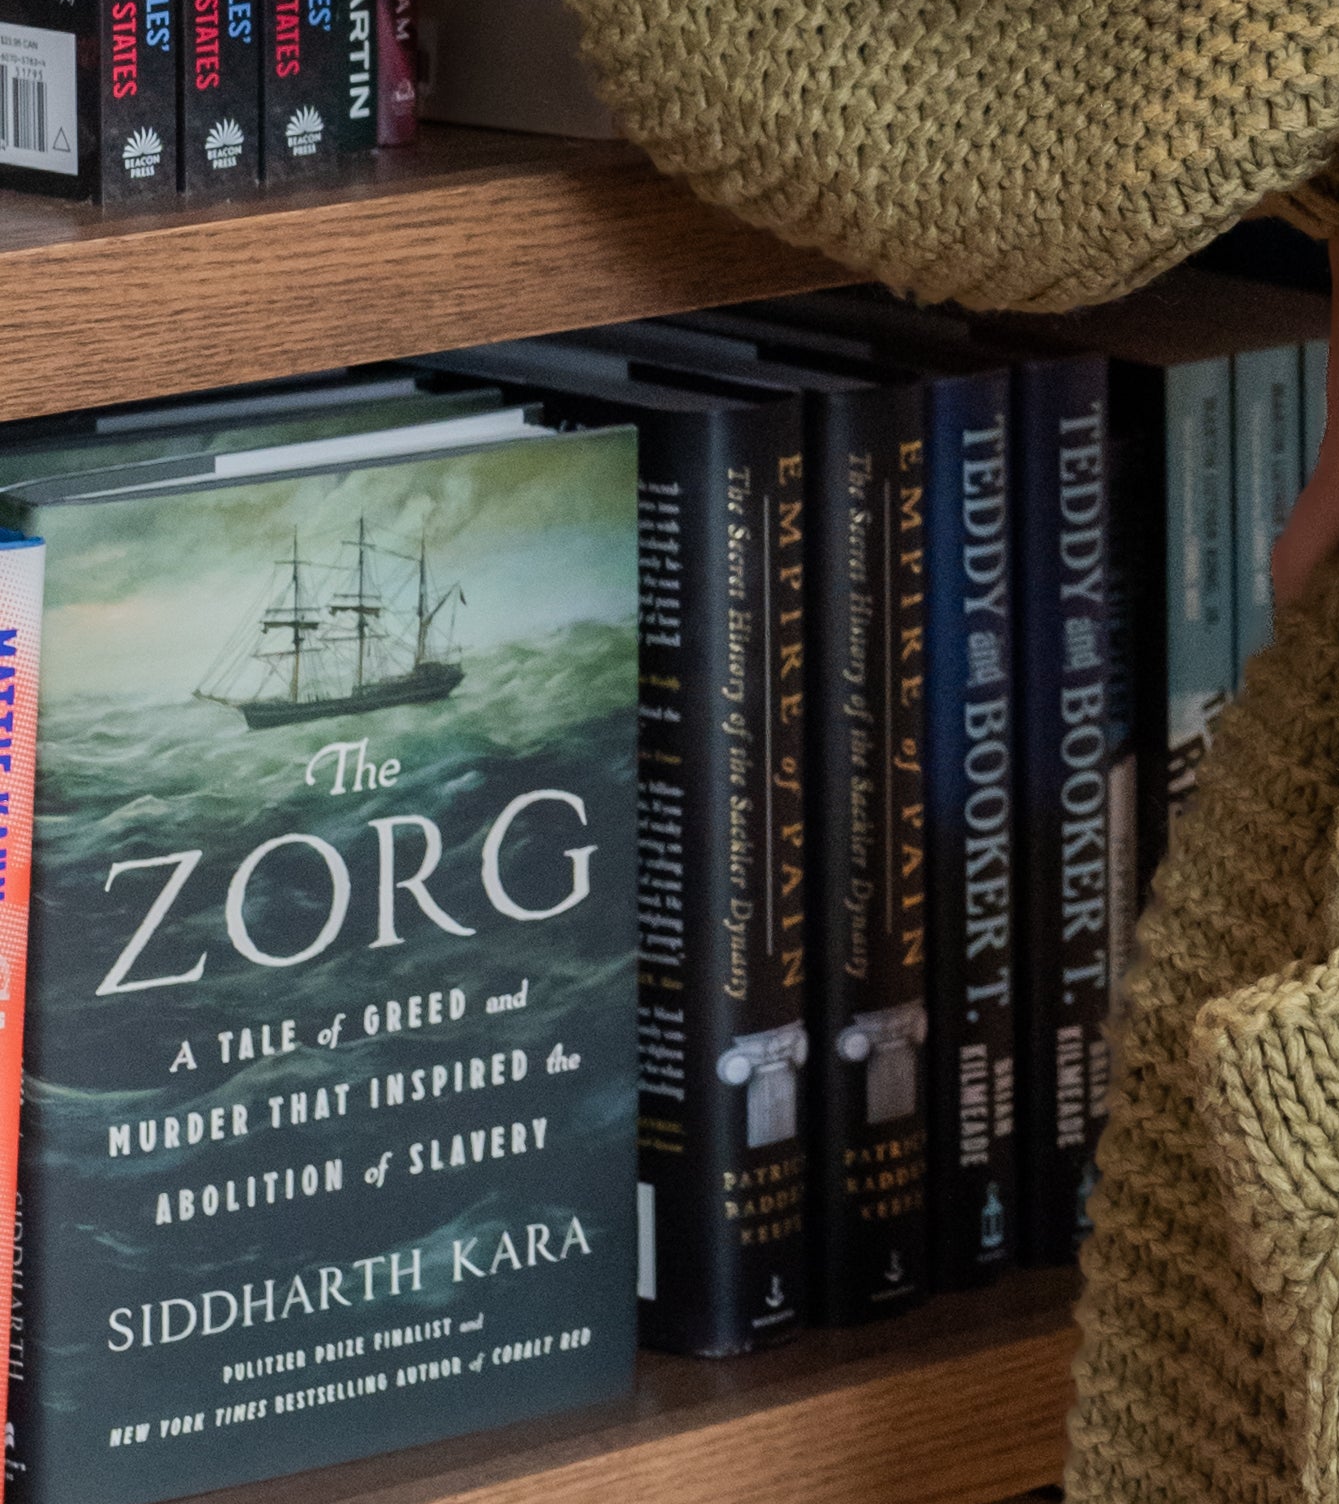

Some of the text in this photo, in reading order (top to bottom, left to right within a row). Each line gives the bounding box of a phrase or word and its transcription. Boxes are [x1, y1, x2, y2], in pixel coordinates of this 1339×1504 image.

[113, 2, 137, 99] STATES
[125, 154, 160, 169] BEACON
[130, 165, 155, 178] PRESS
[207, 145, 242, 160] BEACON
[213, 157, 237, 170] PRESS
[287, 133, 322, 148] BEACON
[293, 144, 317, 156] PRESS
[849, 452, 873, 501] The
[849, 506, 873, 584] Secret
[842, 591, 873, 686] History
[721, 465, 754, 1001] The Secret History of the Sackler Dynasty
[773, 452, 804, 988] EMPIRE of PAIN
[843, 694, 875, 724] of
[894, 439, 925, 968] EMPIRE of PAIN
[962, 413, 1011, 1025] TEDDY and BOOKER T.
[1059, 400, 1106, 1005] TEDDY and BOOKER T.
[306, 737, 400, 795] The
[851, 775, 875, 869] Sackler
[96, 789, 599, 997] ZORG
[843, 876, 875, 980] Dynasty
[169, 978, 529, 1073] A TALE of GREED and
[108, 1042, 582, 1158] MURDER THAT INSPIRED the
[960, 1043, 989, 1168] KILMEADE
[993, 1057, 1015, 1138] BRIAN
[1056, 1025, 1086, 1149] KILMEADE
[155, 1117, 548, 1226] ABOLITION of SLAVERY
[107, 1215, 593, 1353] SIDDHARTH KARA
[109, 1327, 593, 1448] NEW YORK TIMES BESTSELLING AUTHOR of COBALT RED
[223, 1311, 485, 1384] PULITZER PRIZE FINALIST and
